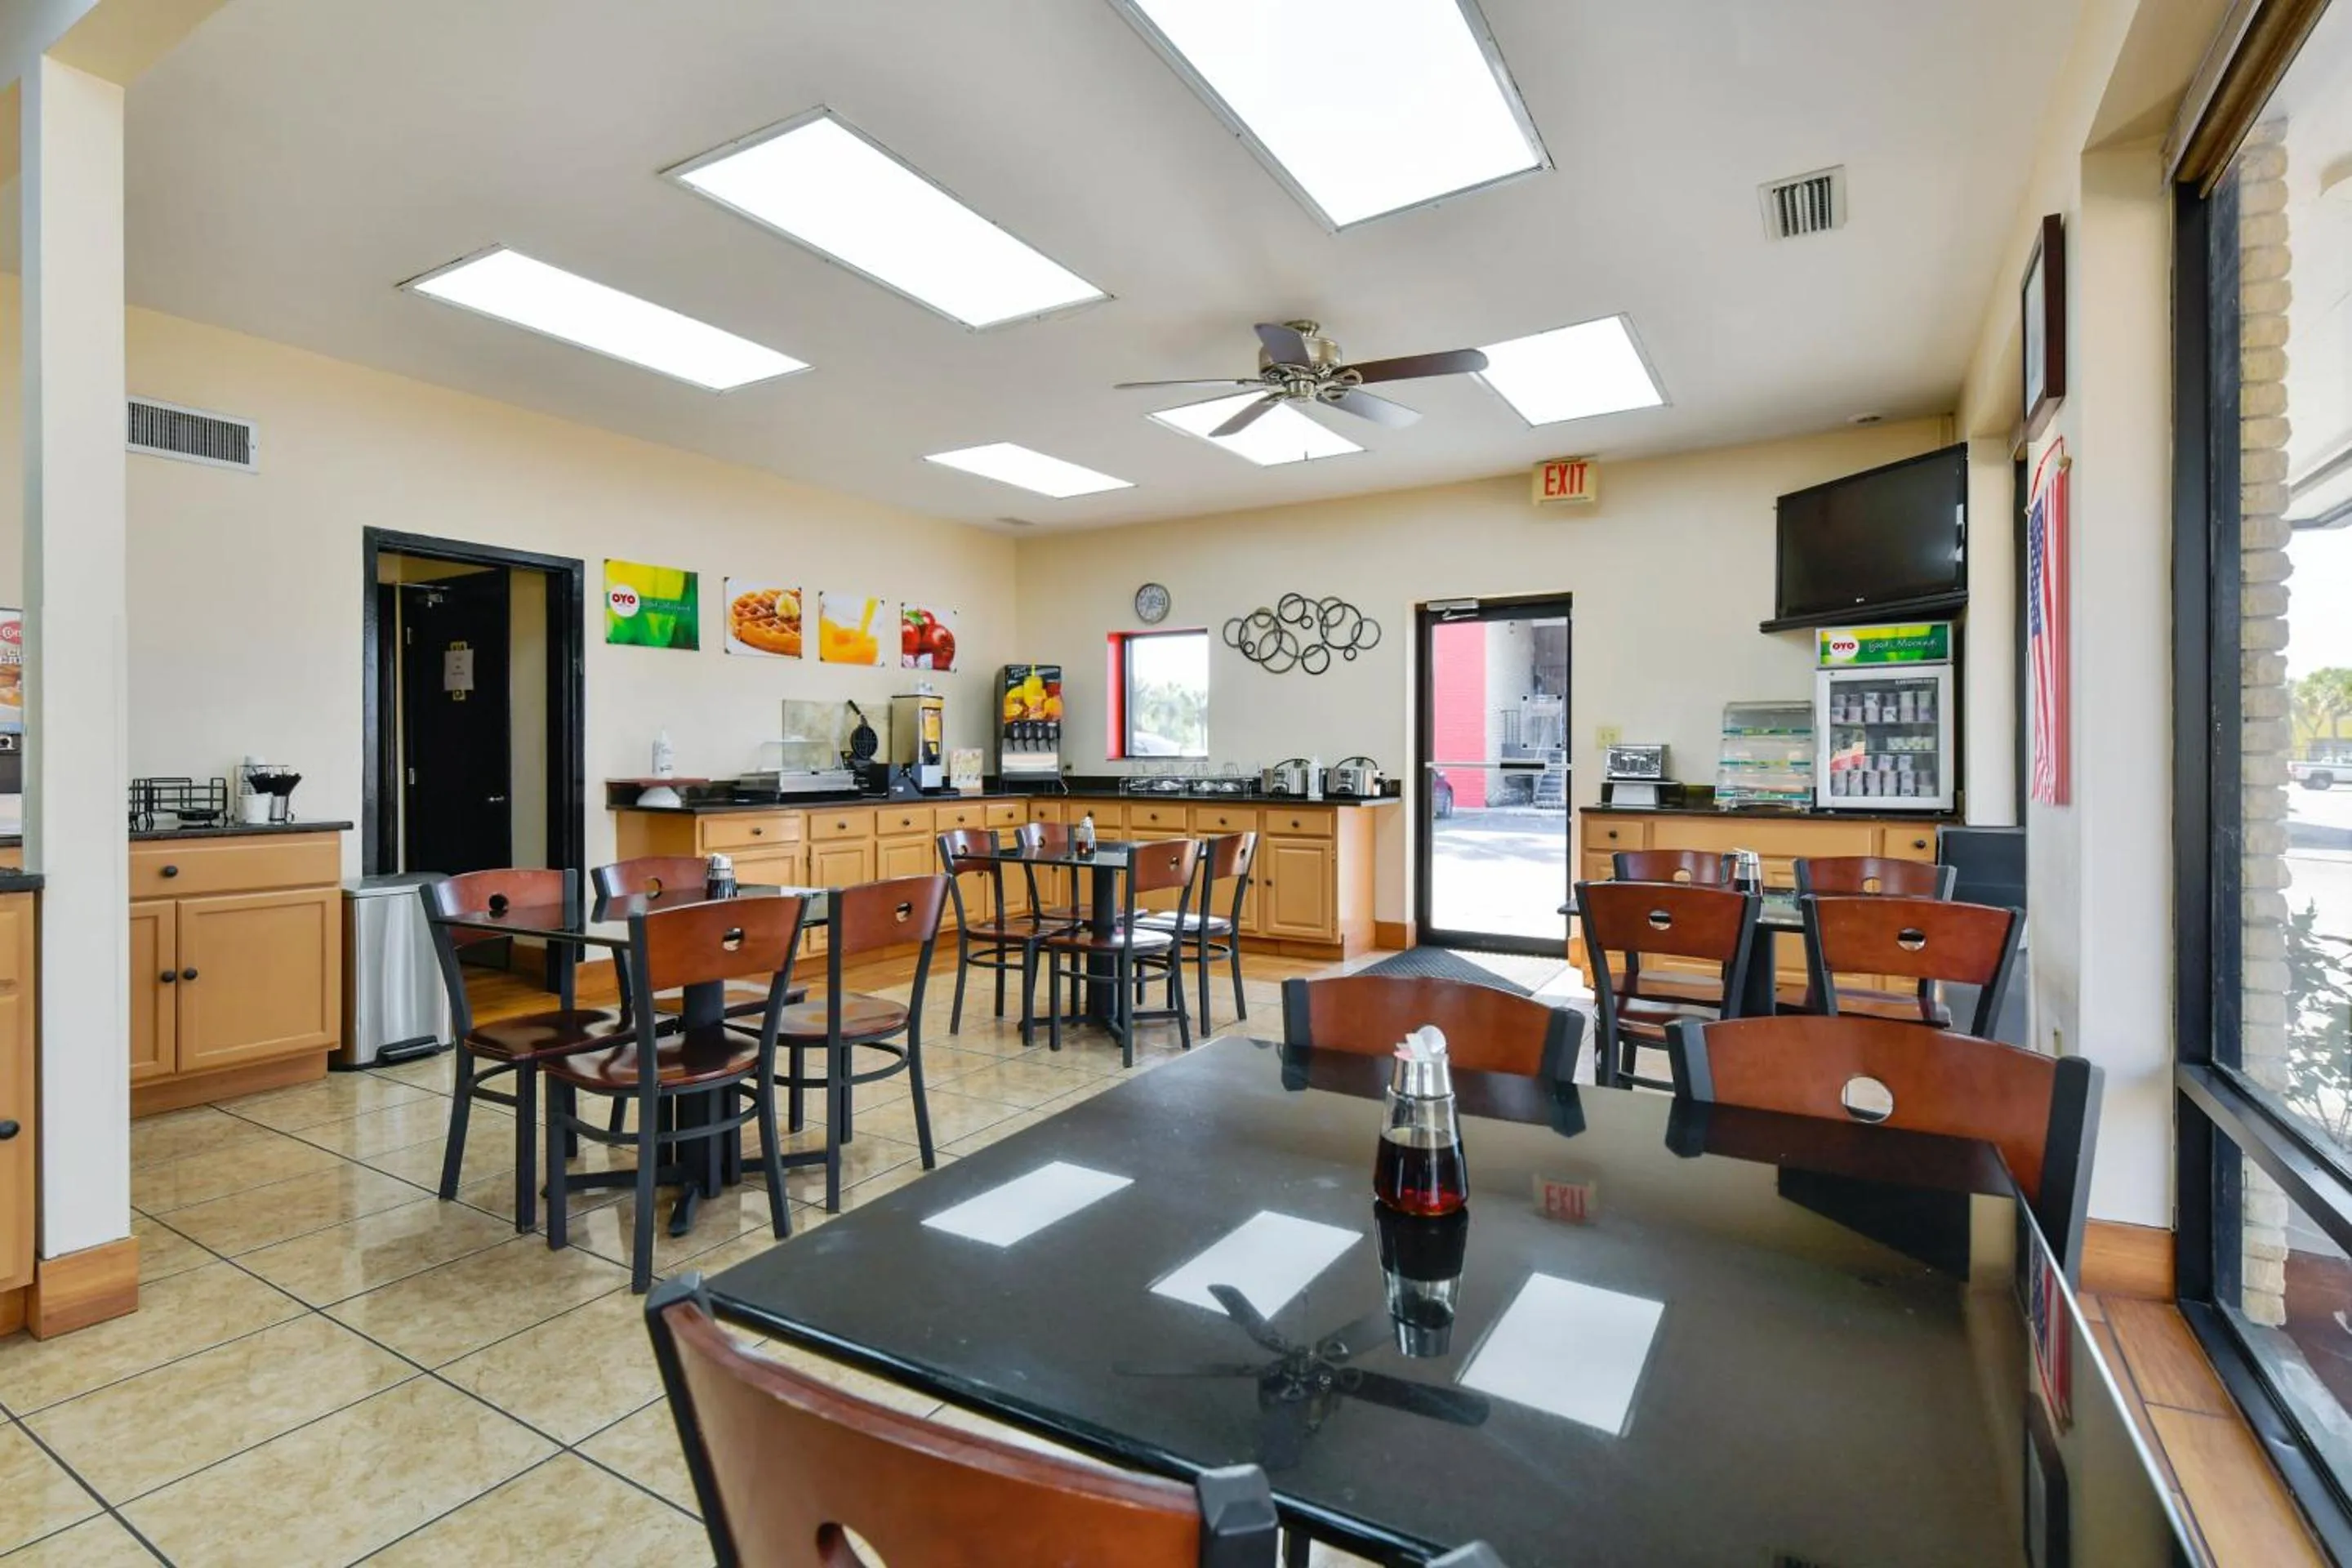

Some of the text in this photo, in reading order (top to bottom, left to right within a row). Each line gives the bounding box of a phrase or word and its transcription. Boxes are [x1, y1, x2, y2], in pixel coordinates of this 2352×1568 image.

[1544, 463, 1588, 496] EXIT
[612, 594, 635, 604] OYO
[1833, 642, 1855, 650] OYO
